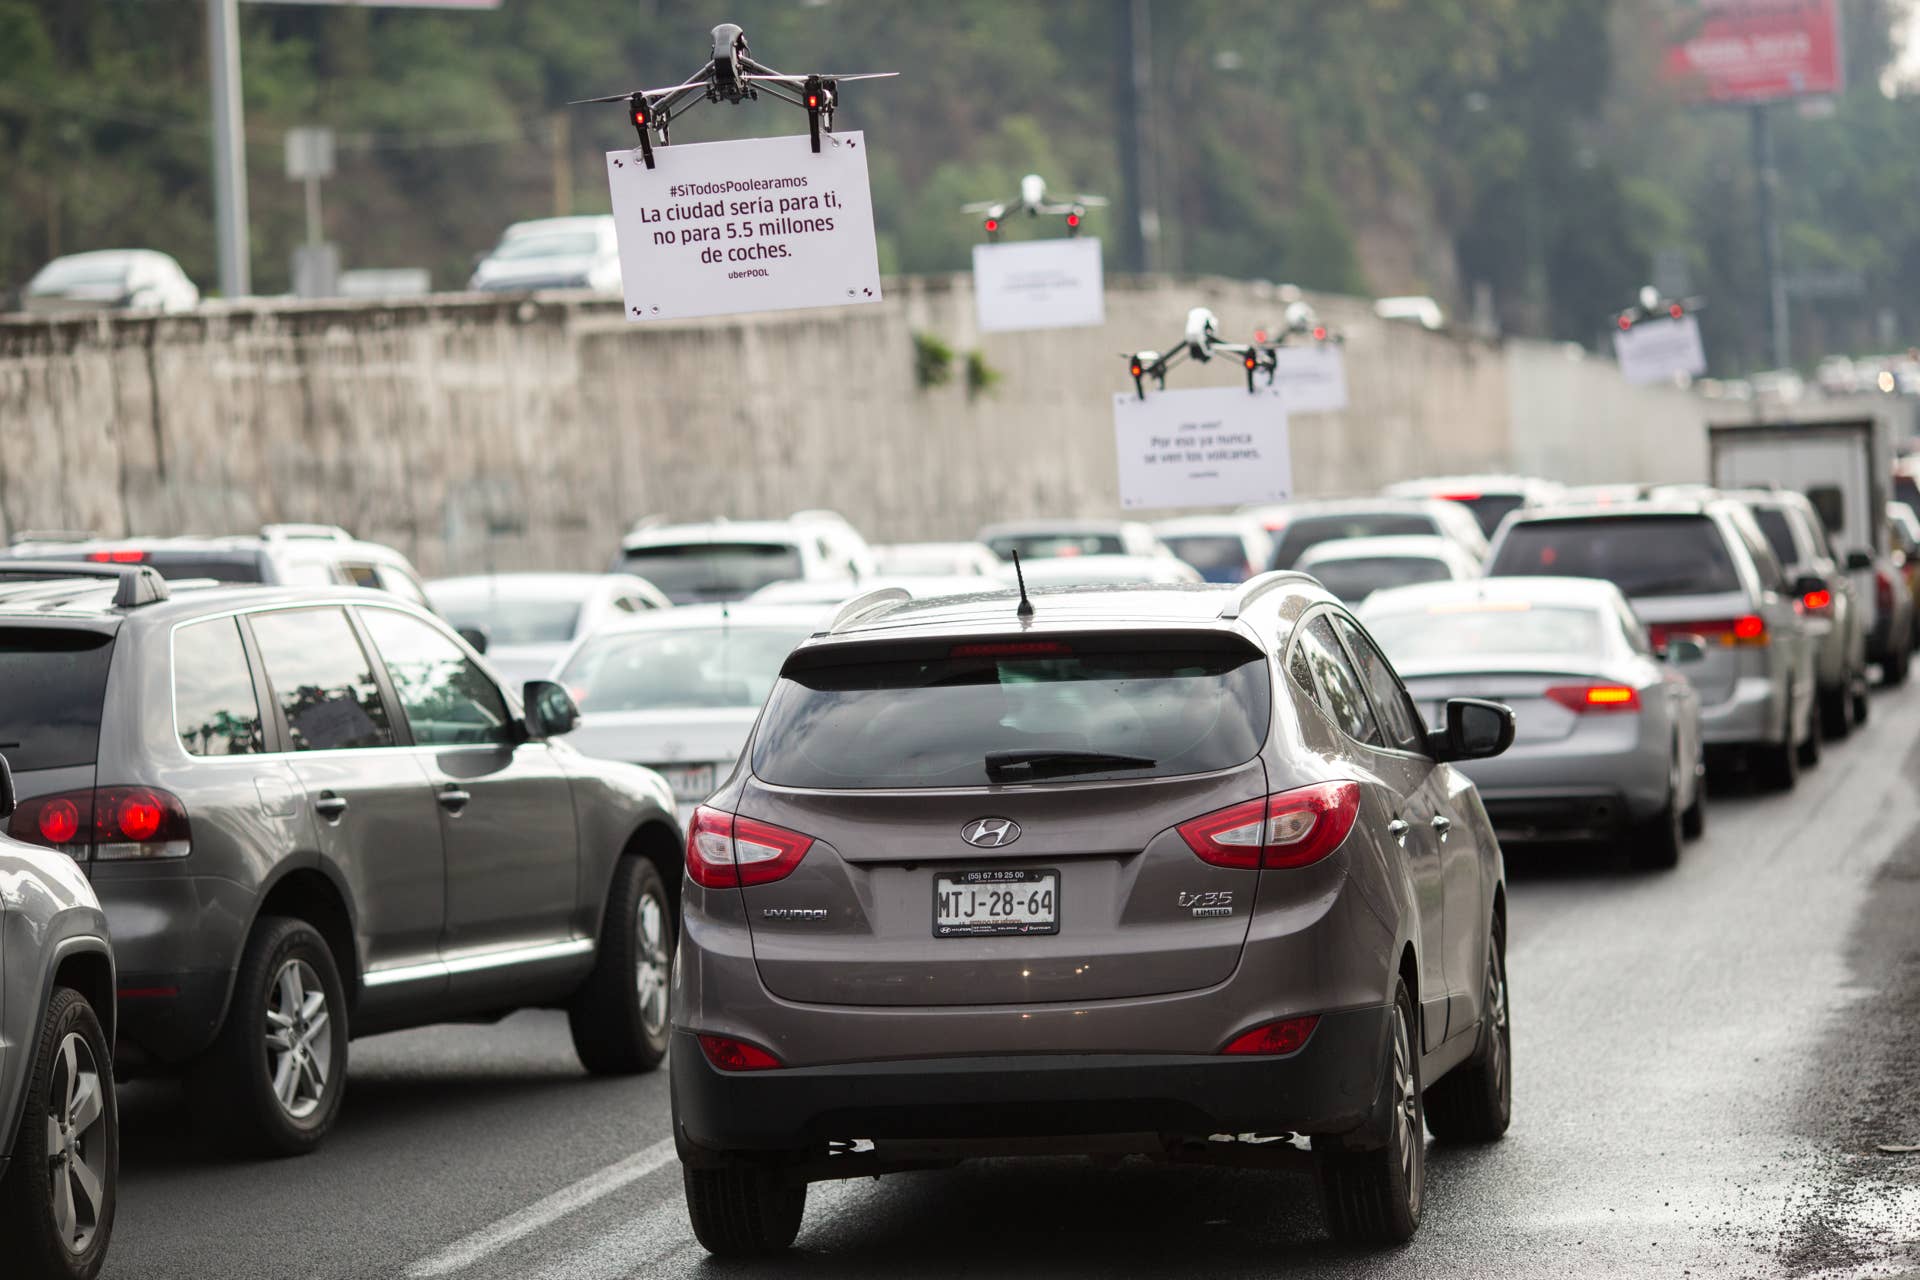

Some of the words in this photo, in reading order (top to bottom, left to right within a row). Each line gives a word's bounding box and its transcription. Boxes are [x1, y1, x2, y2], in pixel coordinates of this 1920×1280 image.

[670, 176, 808, 198] #SiTodosPoolearamos
[640, 206, 661, 223] La
[666, 200, 725, 222] ciudad
[730, 195, 774, 216] sería
[779, 194, 819, 215] para
[823, 190, 843, 210] ti,
[653, 229, 676, 246] no
[681, 226, 721, 246] para
[727, 221, 753, 239] 5.5
[759, 216, 834, 236] millones
[701, 247, 723, 264] de
[728, 242, 792, 262] coches.
[728, 268, 769, 280] uberPOOL
[763, 909, 828, 920] HYUNDAI
[938, 889, 1052, 918] MTJ-28-64
[1195, 908, 1231, 917] LIMITED
